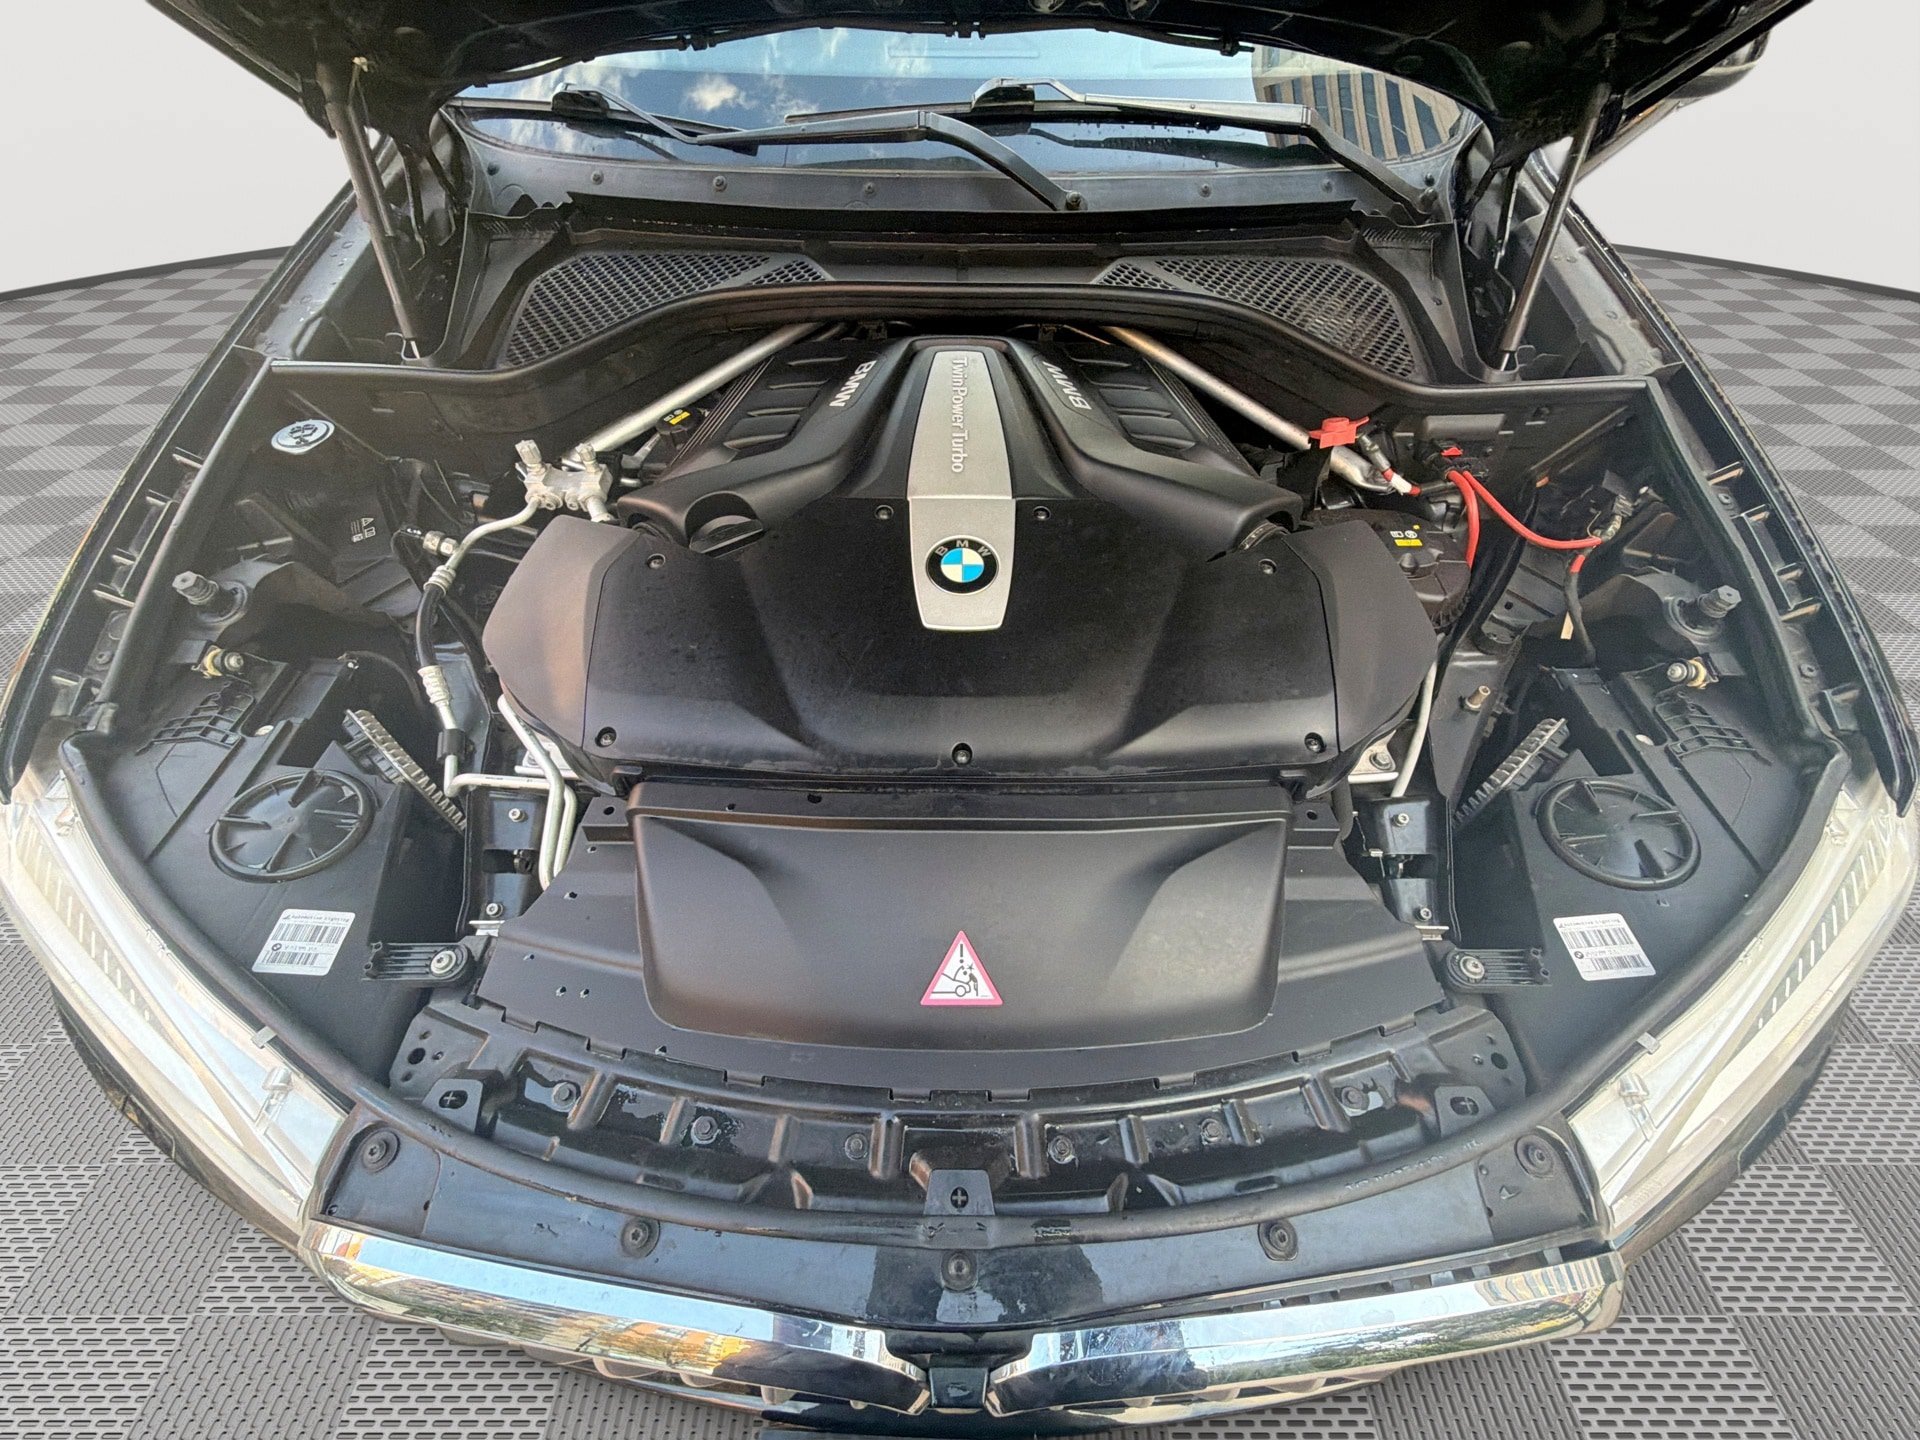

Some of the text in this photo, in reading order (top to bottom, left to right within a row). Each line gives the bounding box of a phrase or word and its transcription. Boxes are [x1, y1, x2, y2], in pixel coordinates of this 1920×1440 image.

[829, 360, 877, 407] BMW
[1042, 361, 1092, 410] BMW
[934, 539, 992, 557] BMW
